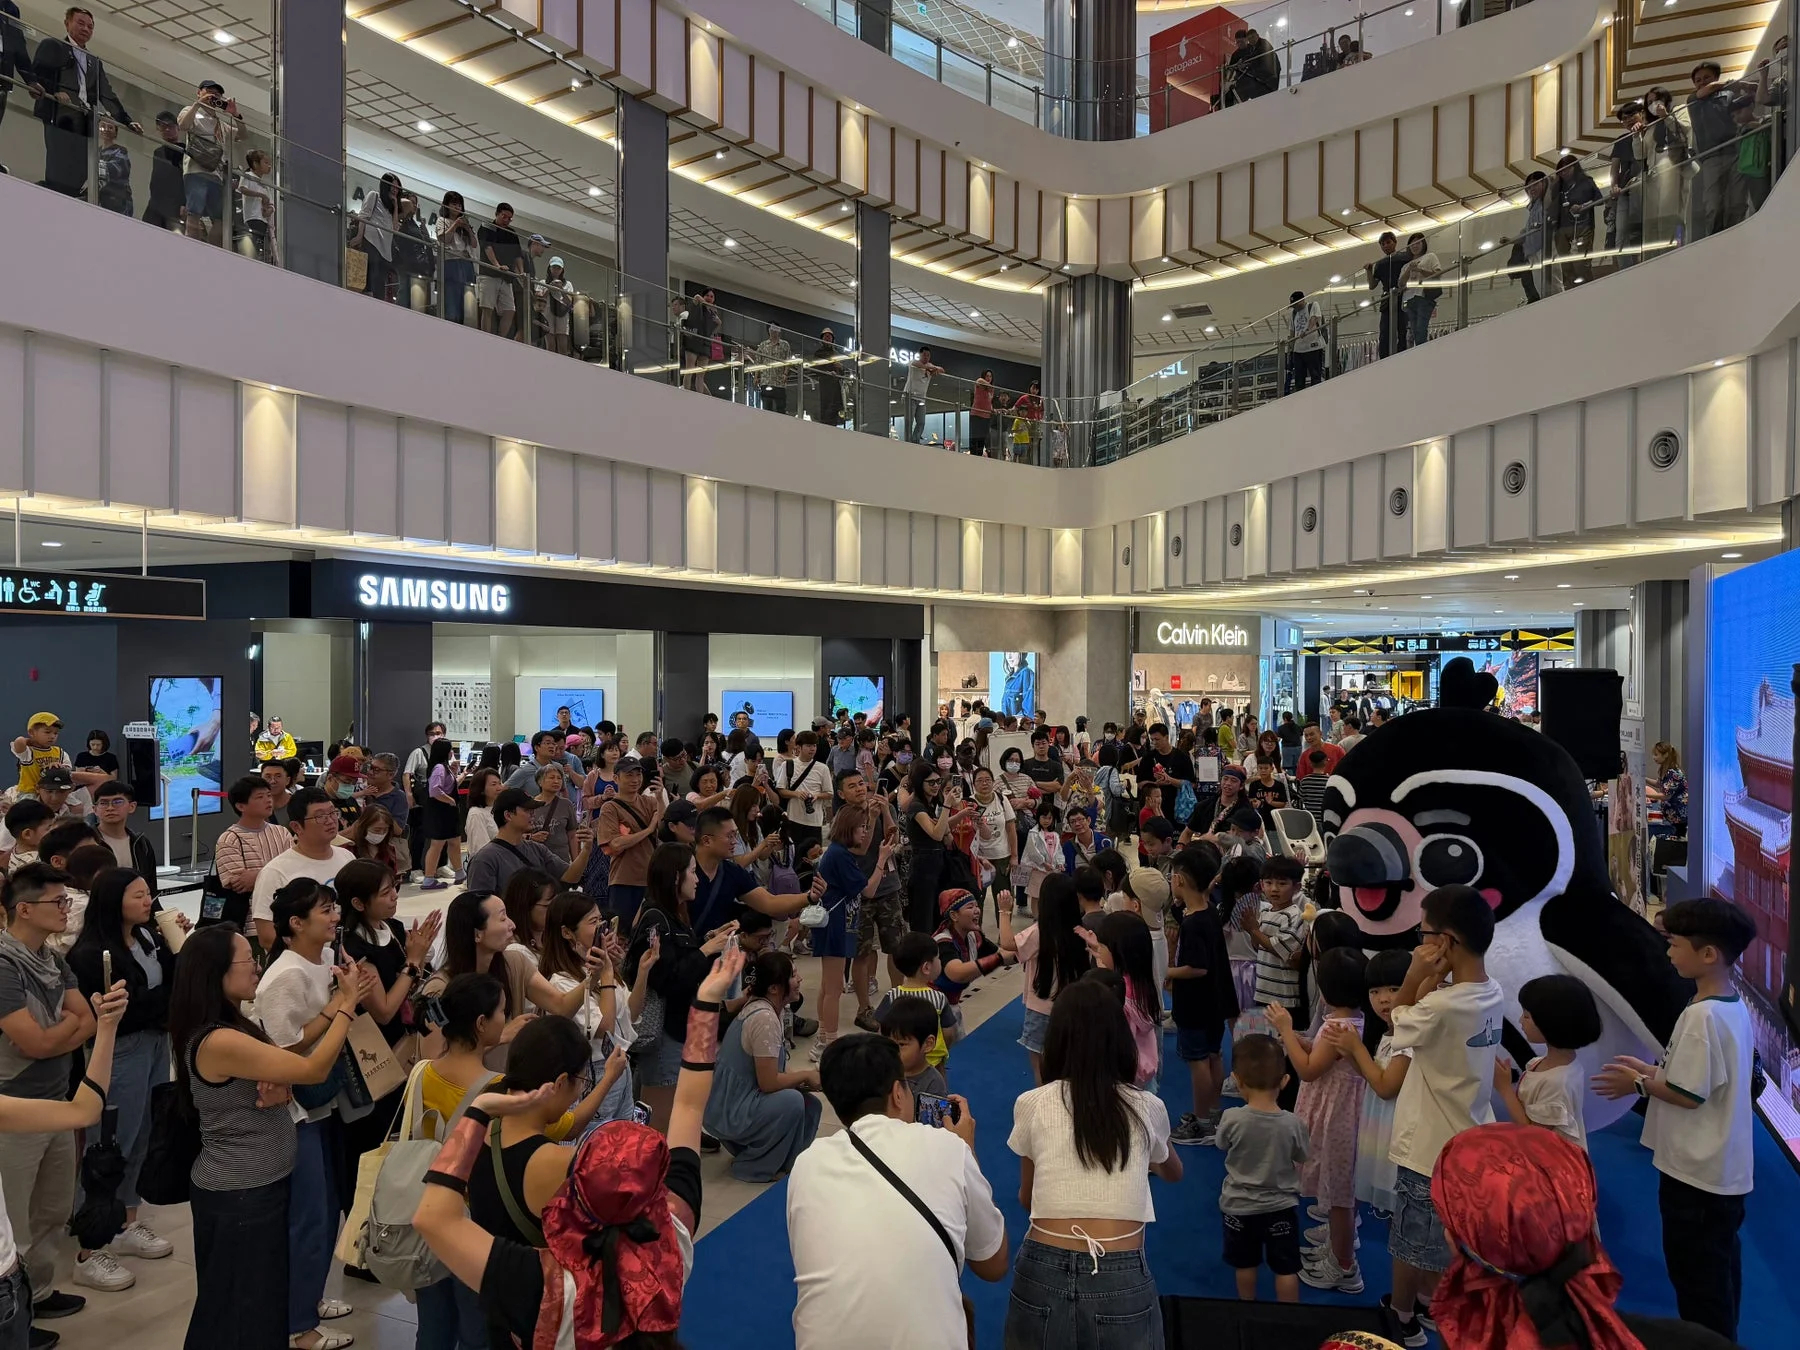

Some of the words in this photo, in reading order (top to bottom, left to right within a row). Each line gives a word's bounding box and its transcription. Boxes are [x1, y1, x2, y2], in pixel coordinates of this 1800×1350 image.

[1164, 53, 1203, 76] cotopaxi
[30, 580, 41, 588] WC
[359, 574, 508, 612] SAMSUNG
[1157, 621, 1210, 645] Calvin
[1211, 623, 1248, 646] Klein
